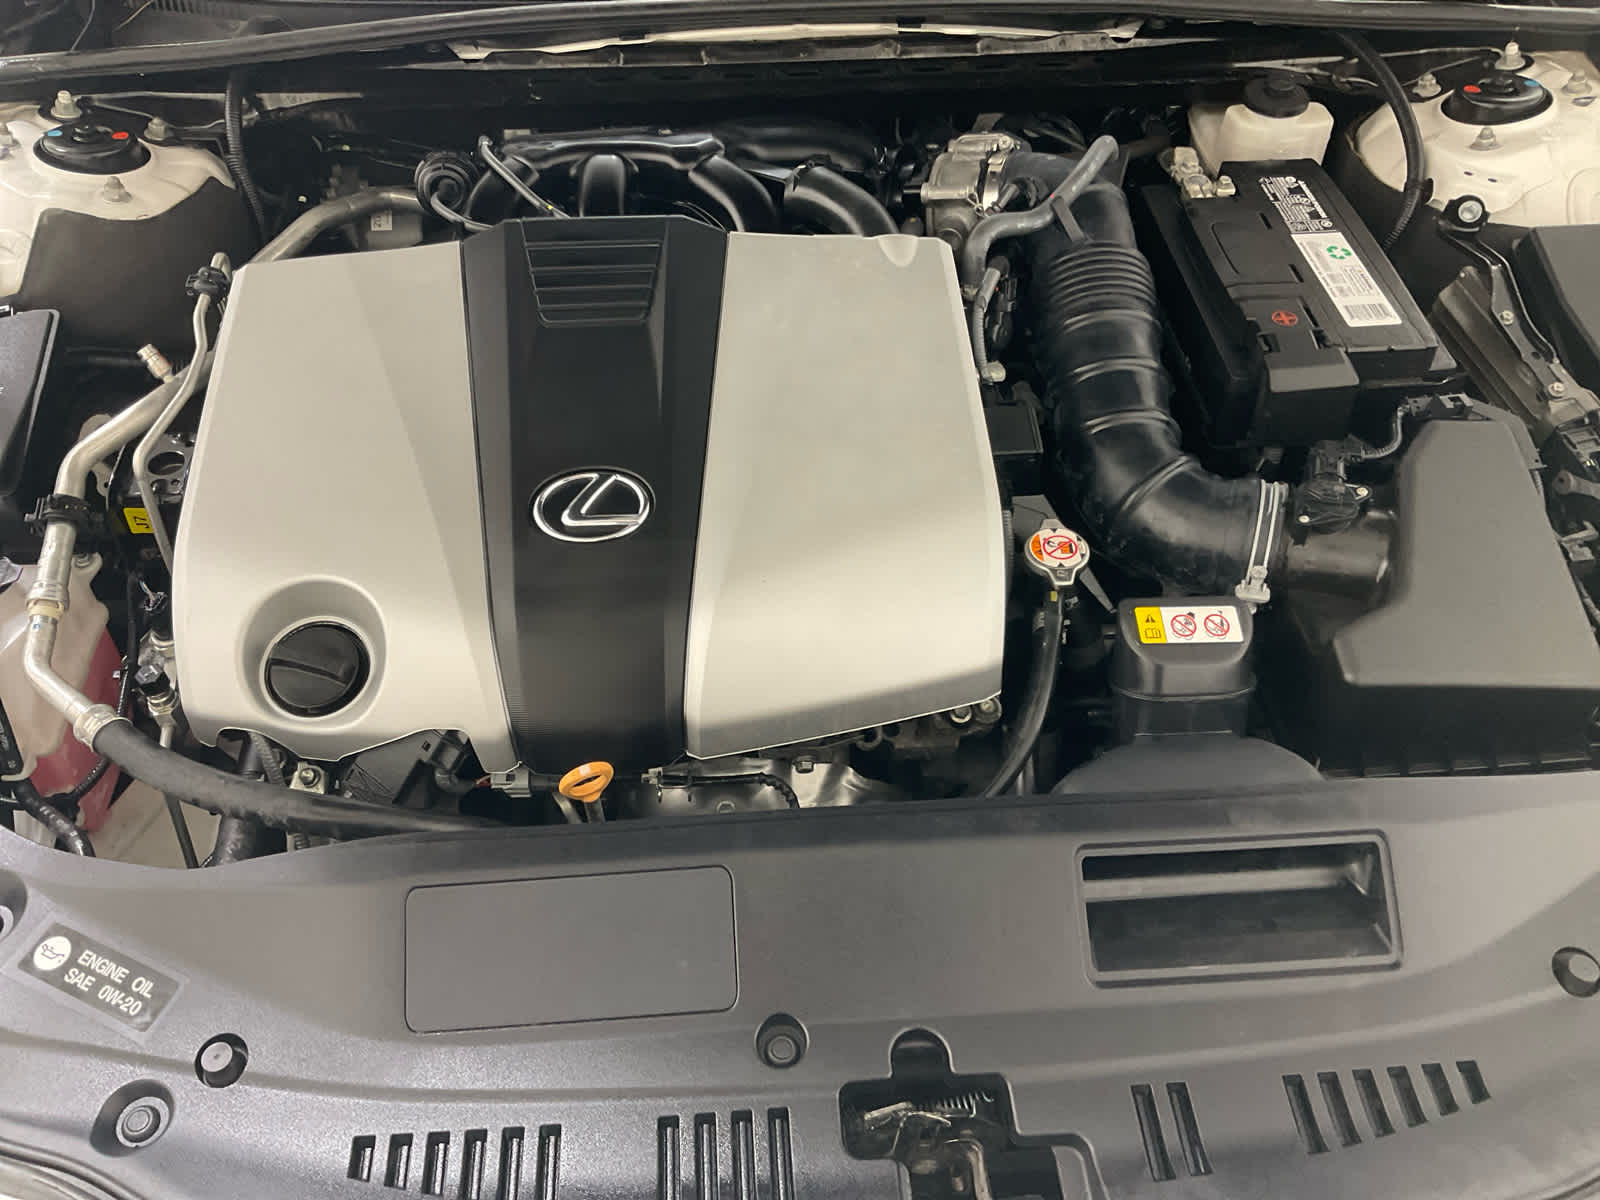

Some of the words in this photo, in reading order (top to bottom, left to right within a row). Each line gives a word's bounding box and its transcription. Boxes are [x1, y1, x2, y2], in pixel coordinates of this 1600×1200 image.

[134, 516, 149, 528] J7
[63, 967, 96, 992] SAE
[97, 985, 143, 1016] 0W-20
[77, 949, 130, 984] ENGINE
[131, 976, 155, 999] OIL
